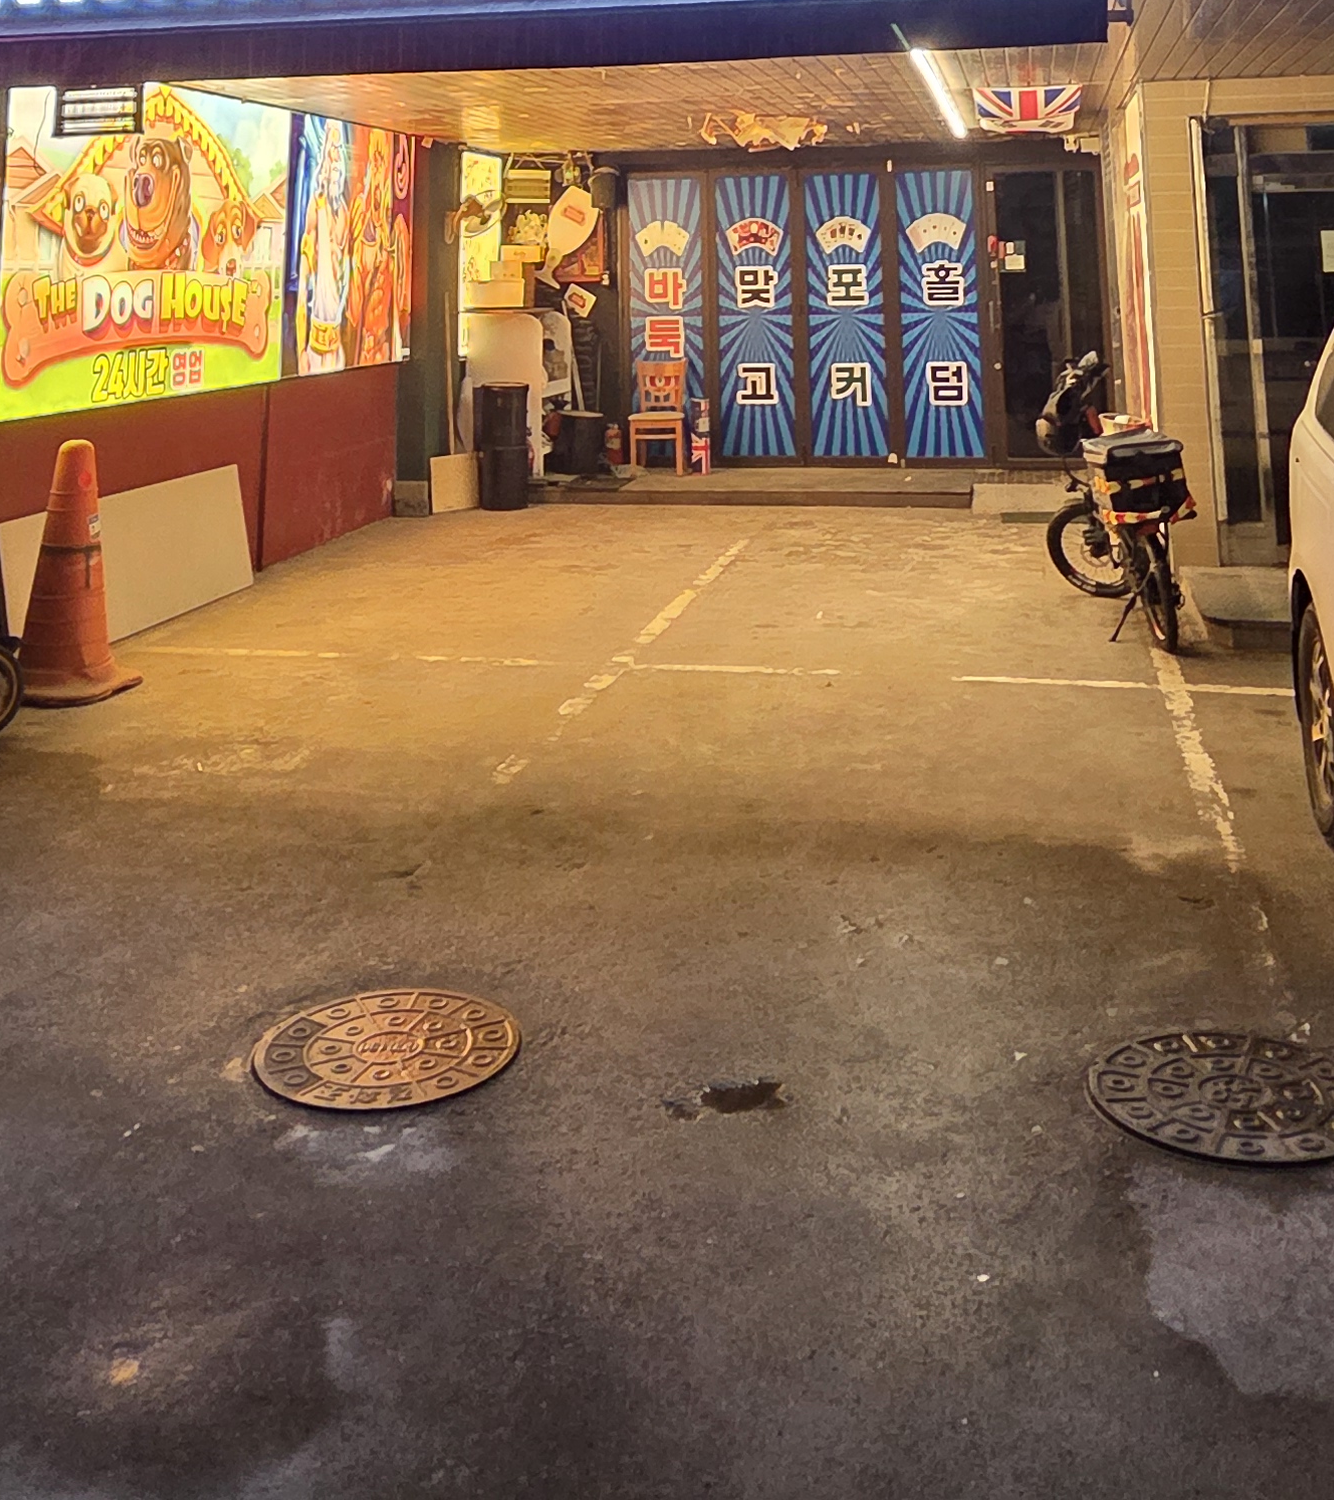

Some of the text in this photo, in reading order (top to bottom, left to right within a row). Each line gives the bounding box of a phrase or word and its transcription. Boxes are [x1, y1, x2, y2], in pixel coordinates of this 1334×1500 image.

[91, 347, 203, 403] 24시간 영업
[735, 265, 778, 406] 맞고
[826, 264, 872, 406] 포커
[921, 261, 968, 406] 홀덤
